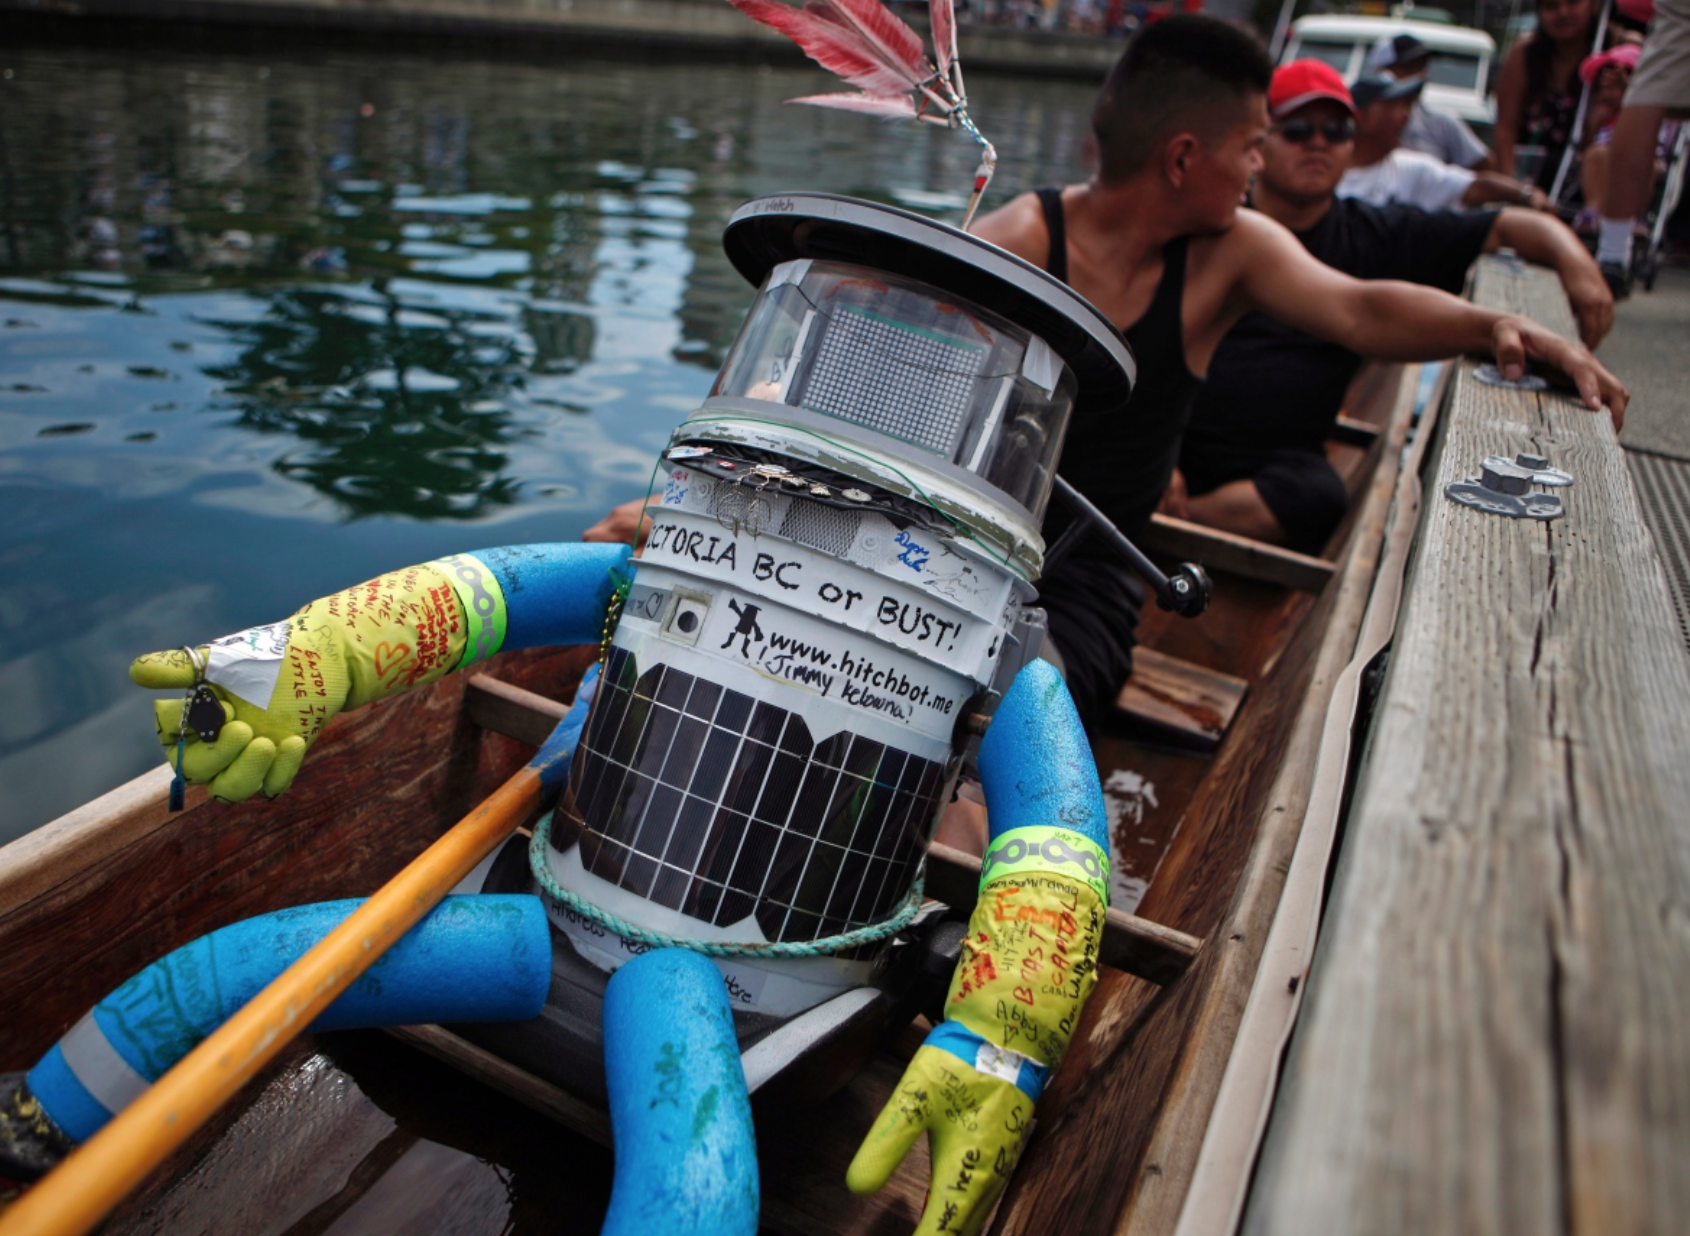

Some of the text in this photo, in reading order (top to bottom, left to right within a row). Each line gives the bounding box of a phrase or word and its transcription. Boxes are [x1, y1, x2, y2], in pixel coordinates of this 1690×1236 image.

[753, 552, 803, 590] BC
[818, 582, 863, 611] or
[877, 595, 962, 652] BUST!
[290, 645, 308, 699] LITTLE
[304, 649, 327, 698] ENJOY
[769, 631, 954, 715] www.hitchbot.me
[947, 1148, 981, 1192] here
